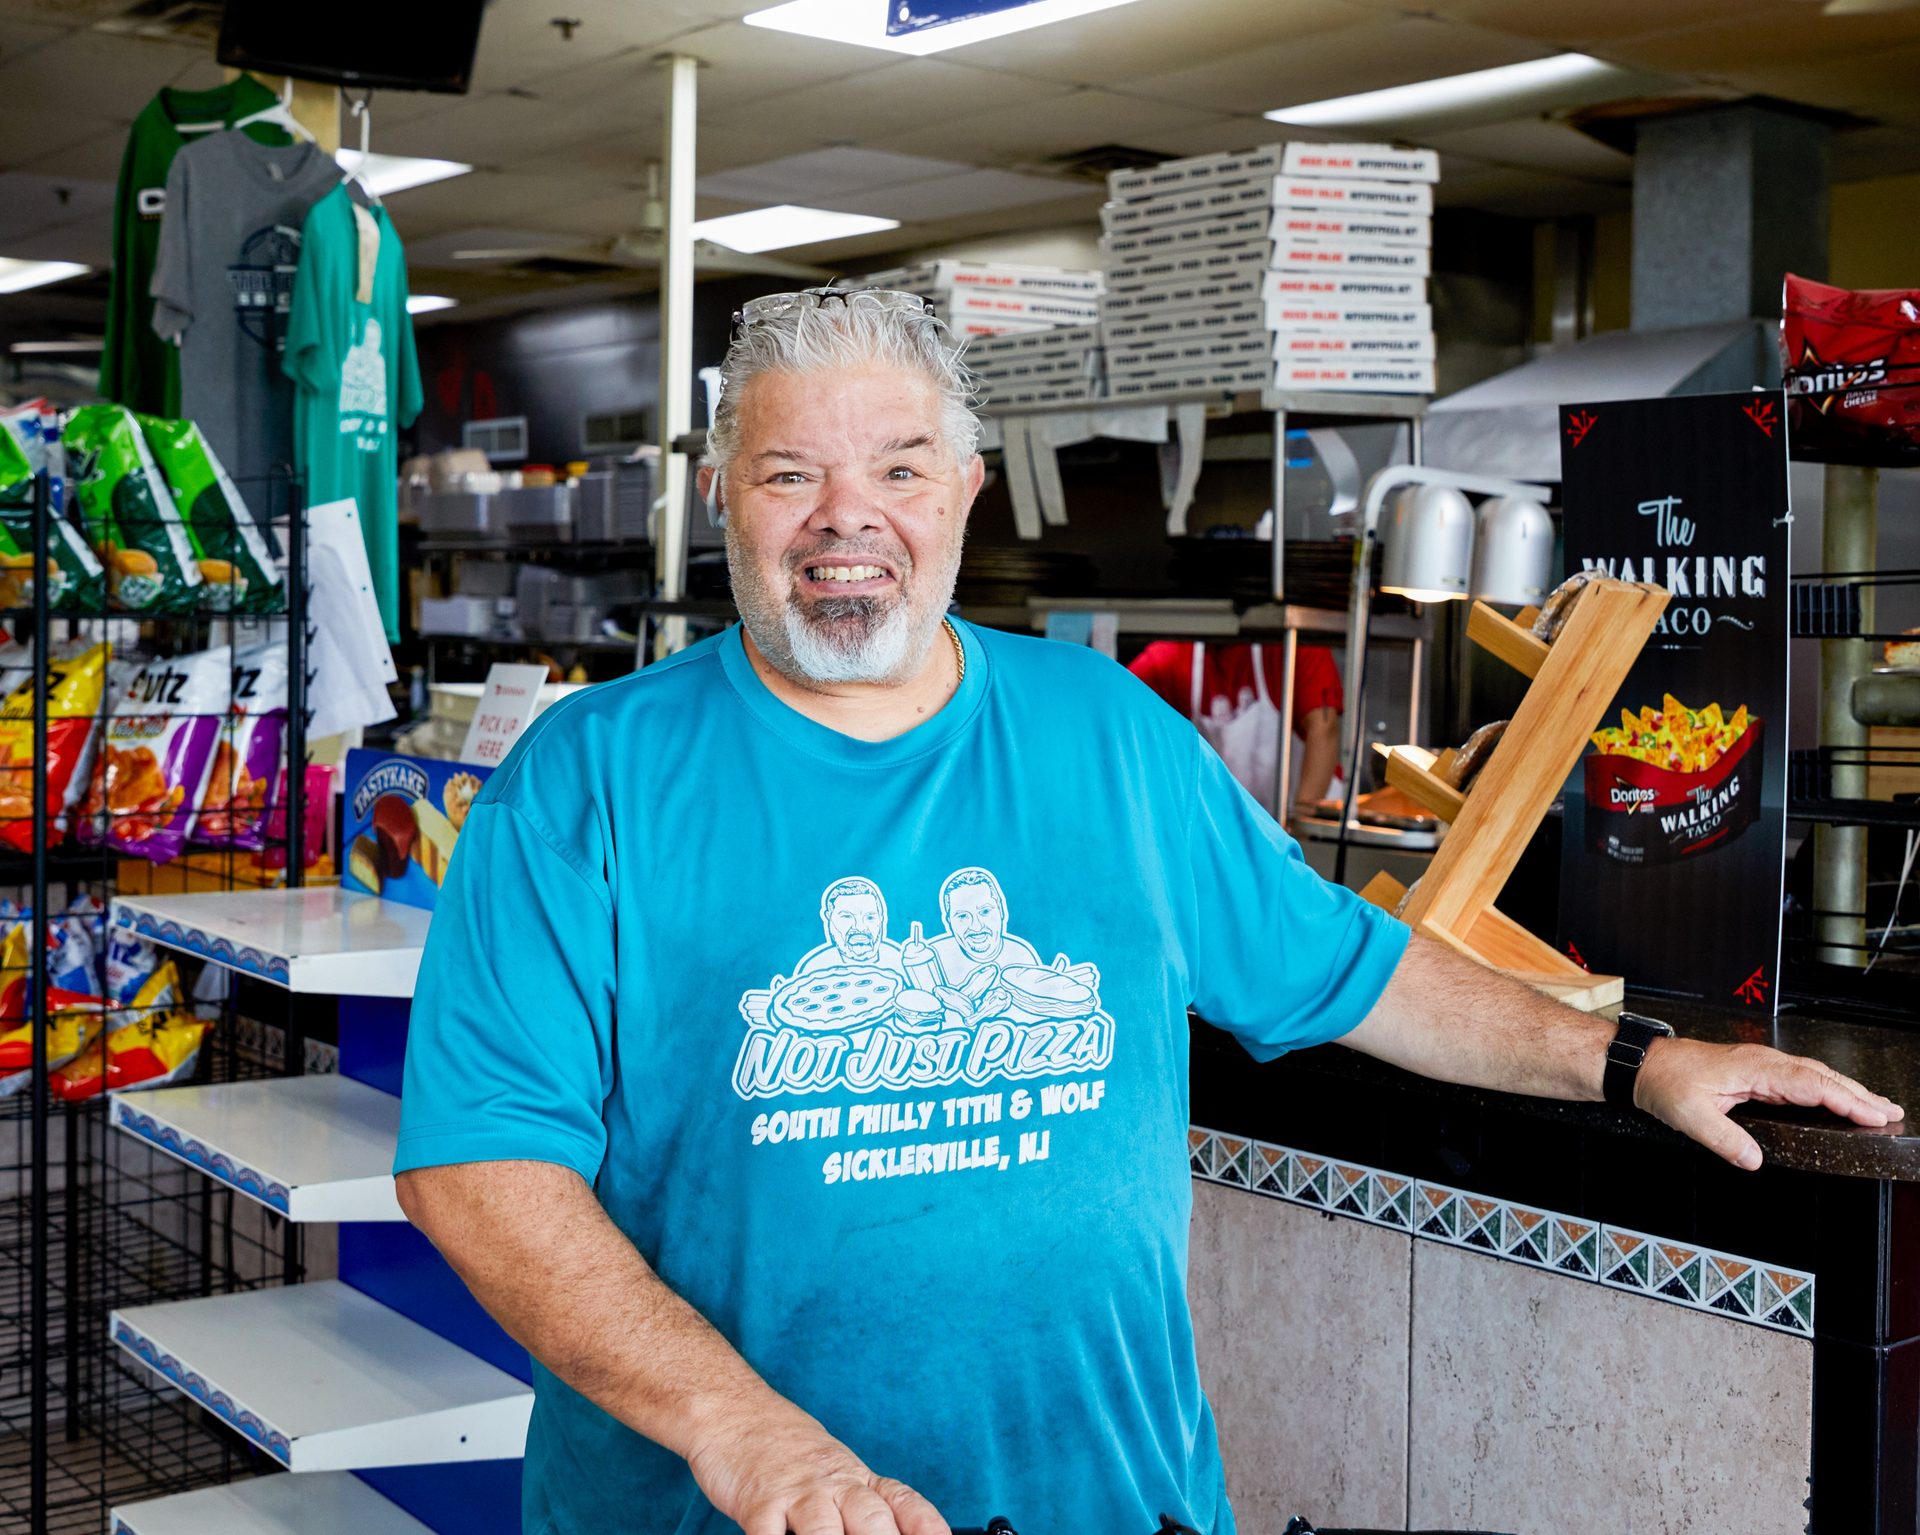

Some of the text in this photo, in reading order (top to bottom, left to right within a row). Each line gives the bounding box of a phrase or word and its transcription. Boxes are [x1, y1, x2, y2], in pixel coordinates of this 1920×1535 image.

[1637, 495, 1696, 547] The
[1652, 607, 1712, 635] ACO
[232, 664, 261, 698] tz
[480, 714, 518, 735] PICK UP
[477, 740, 503, 759] HERE
[354, 765, 426, 816] TASTYKAKE
[1610, 787, 1655, 803] Doritos
[1661, 776, 1741, 834] WALKING
[1686, 784, 1713, 805] The
[1685, 814, 1721, 838] TACO
[742, 1021, 1105, 1089] NOT JUST PIZZA
[750, 1106, 839, 1145] SOUTH
[847, 1099, 936, 1135] PHILLY
[1010, 1089, 1033, 1120] &
[1040, 1079, 1106, 1116] WOLF
[821, 1130, 1050, 1185] SICKLERVILLE, NJ
